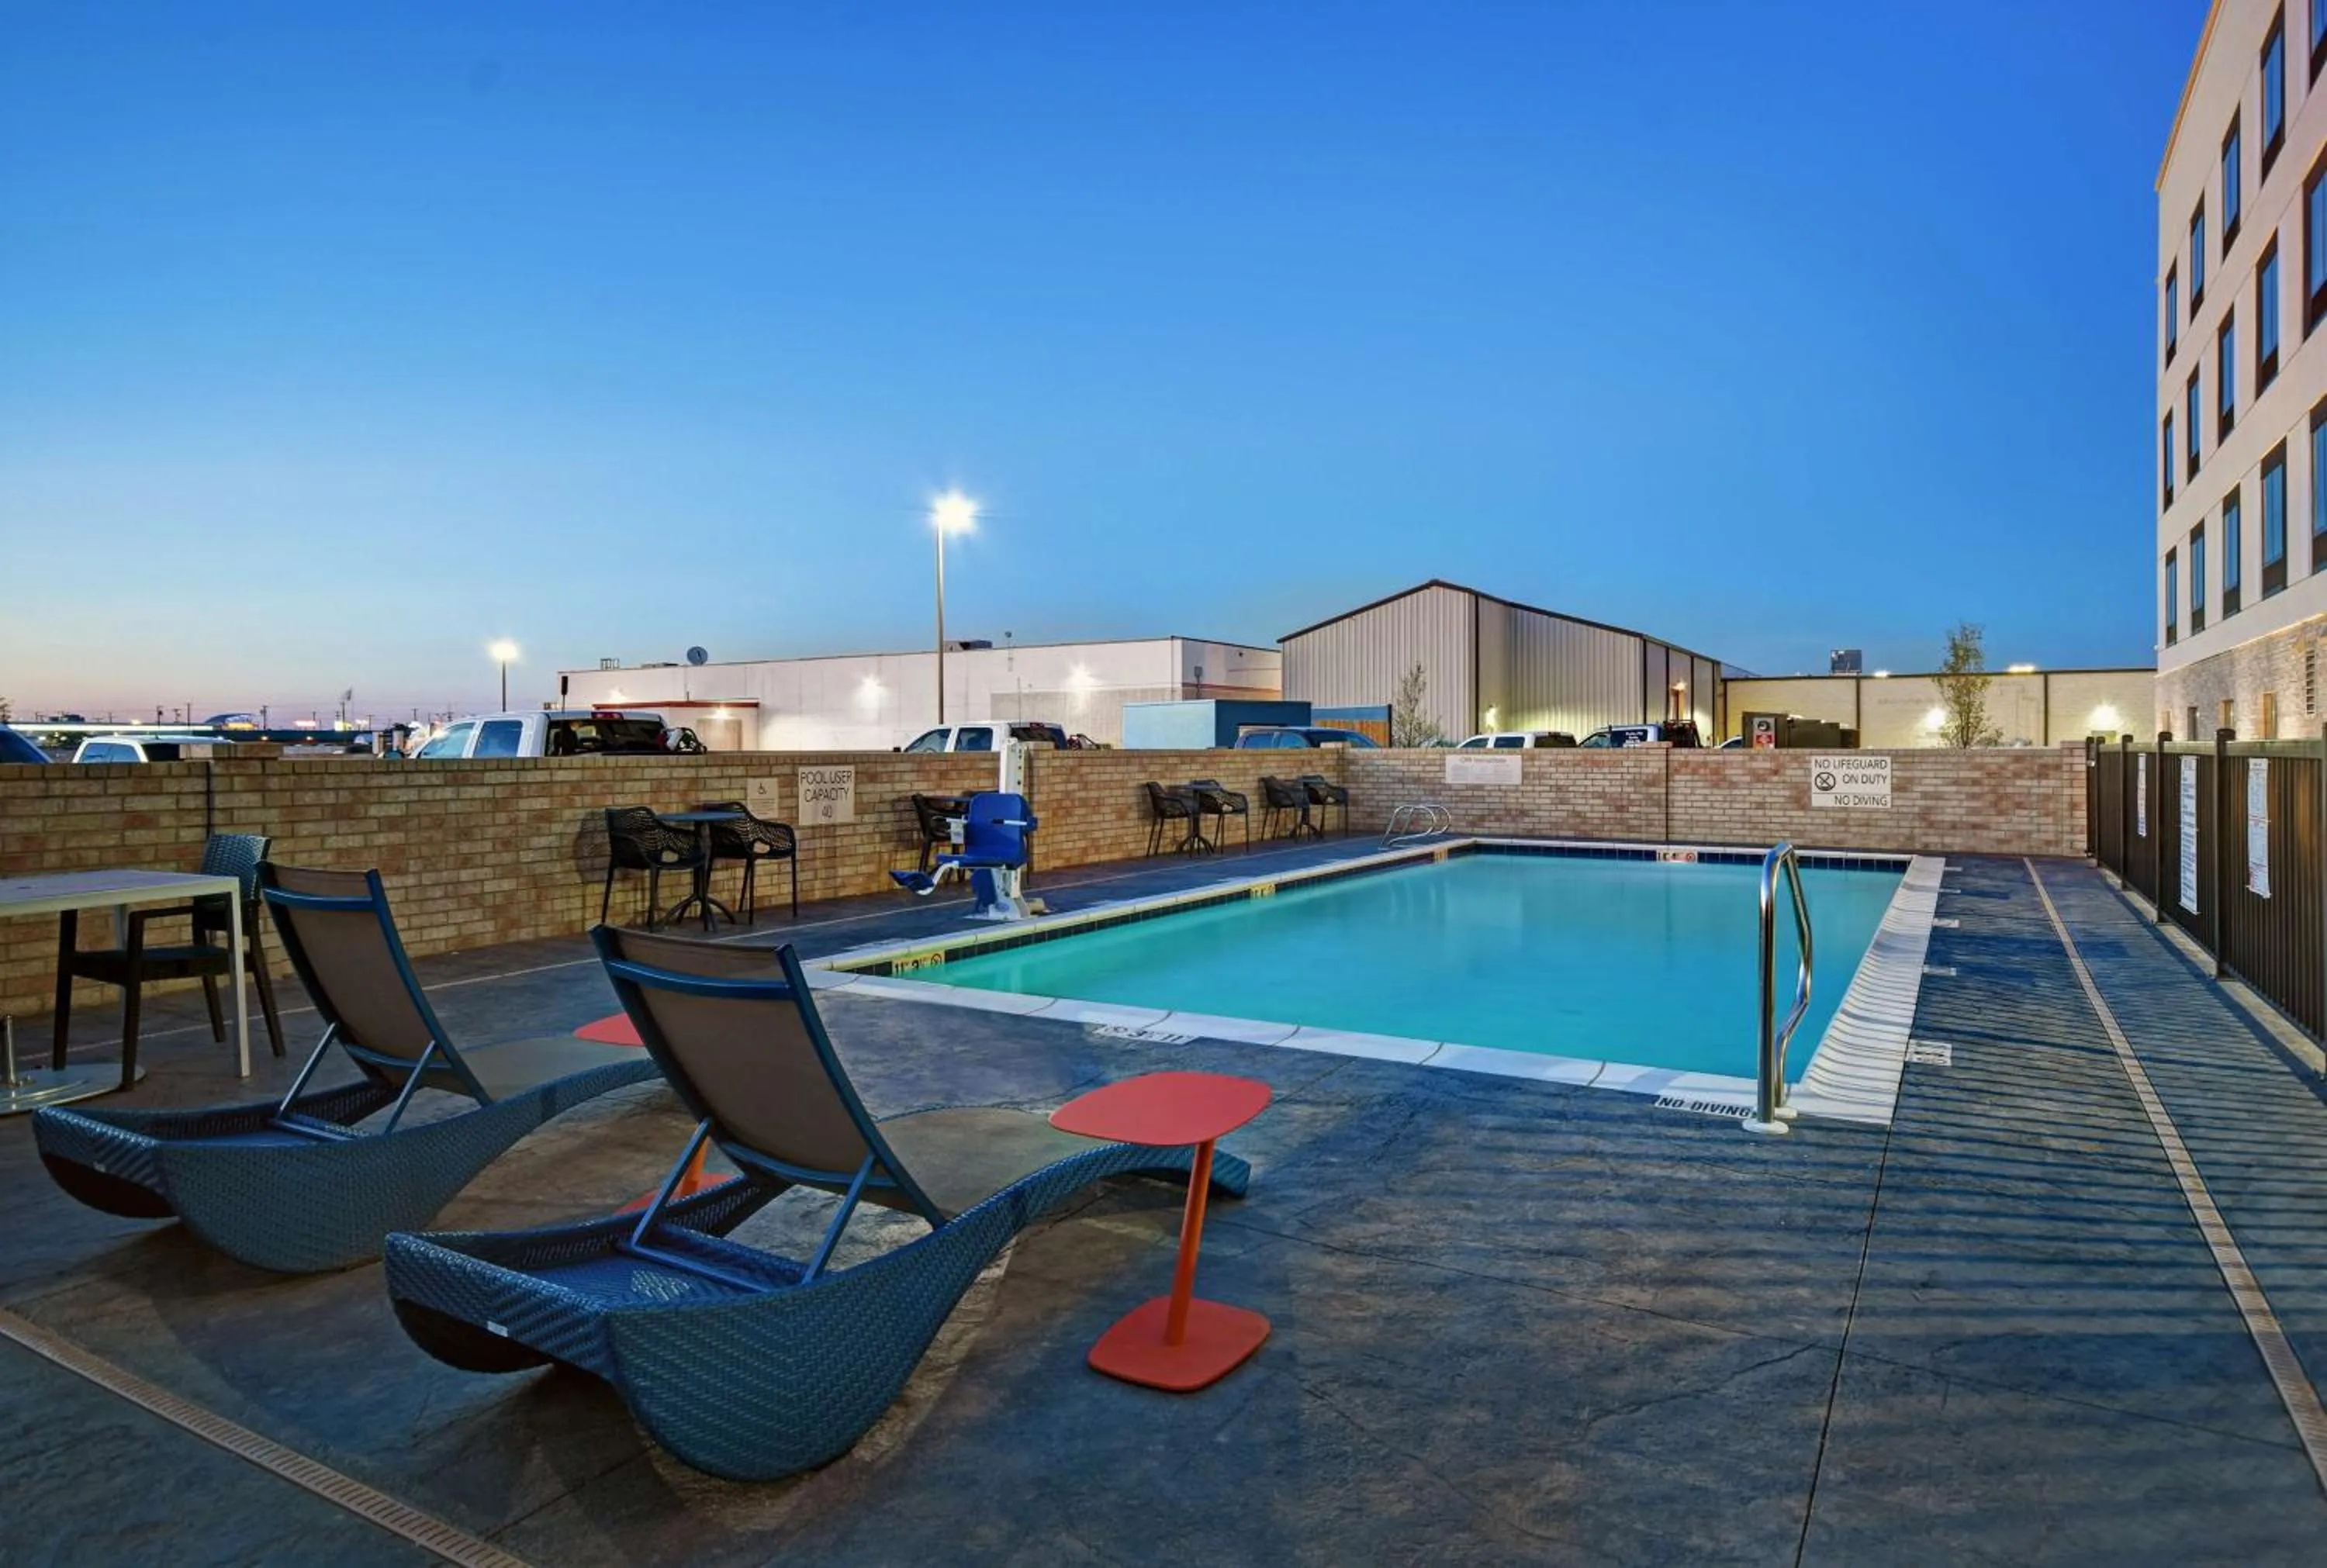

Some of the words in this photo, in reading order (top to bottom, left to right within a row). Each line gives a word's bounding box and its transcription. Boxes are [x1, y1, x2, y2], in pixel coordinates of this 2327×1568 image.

[1815, 759, 1831, 769] NO
[1833, 759, 1887, 770] LIFEGUARD
[800, 770, 828, 786] POOL
[829, 770, 852, 784] USER
[1842, 774, 1858, 785] ON
[1861, 774, 1887, 785] DUTY
[804, 787, 849, 803] CAPACITY
[1834, 795, 1850, 806] NO
[1852, 795, 1887, 806] DIVING
[1658, 1097, 1685, 1108] NO
[1690, 1100, 1751, 1117] DIVING
